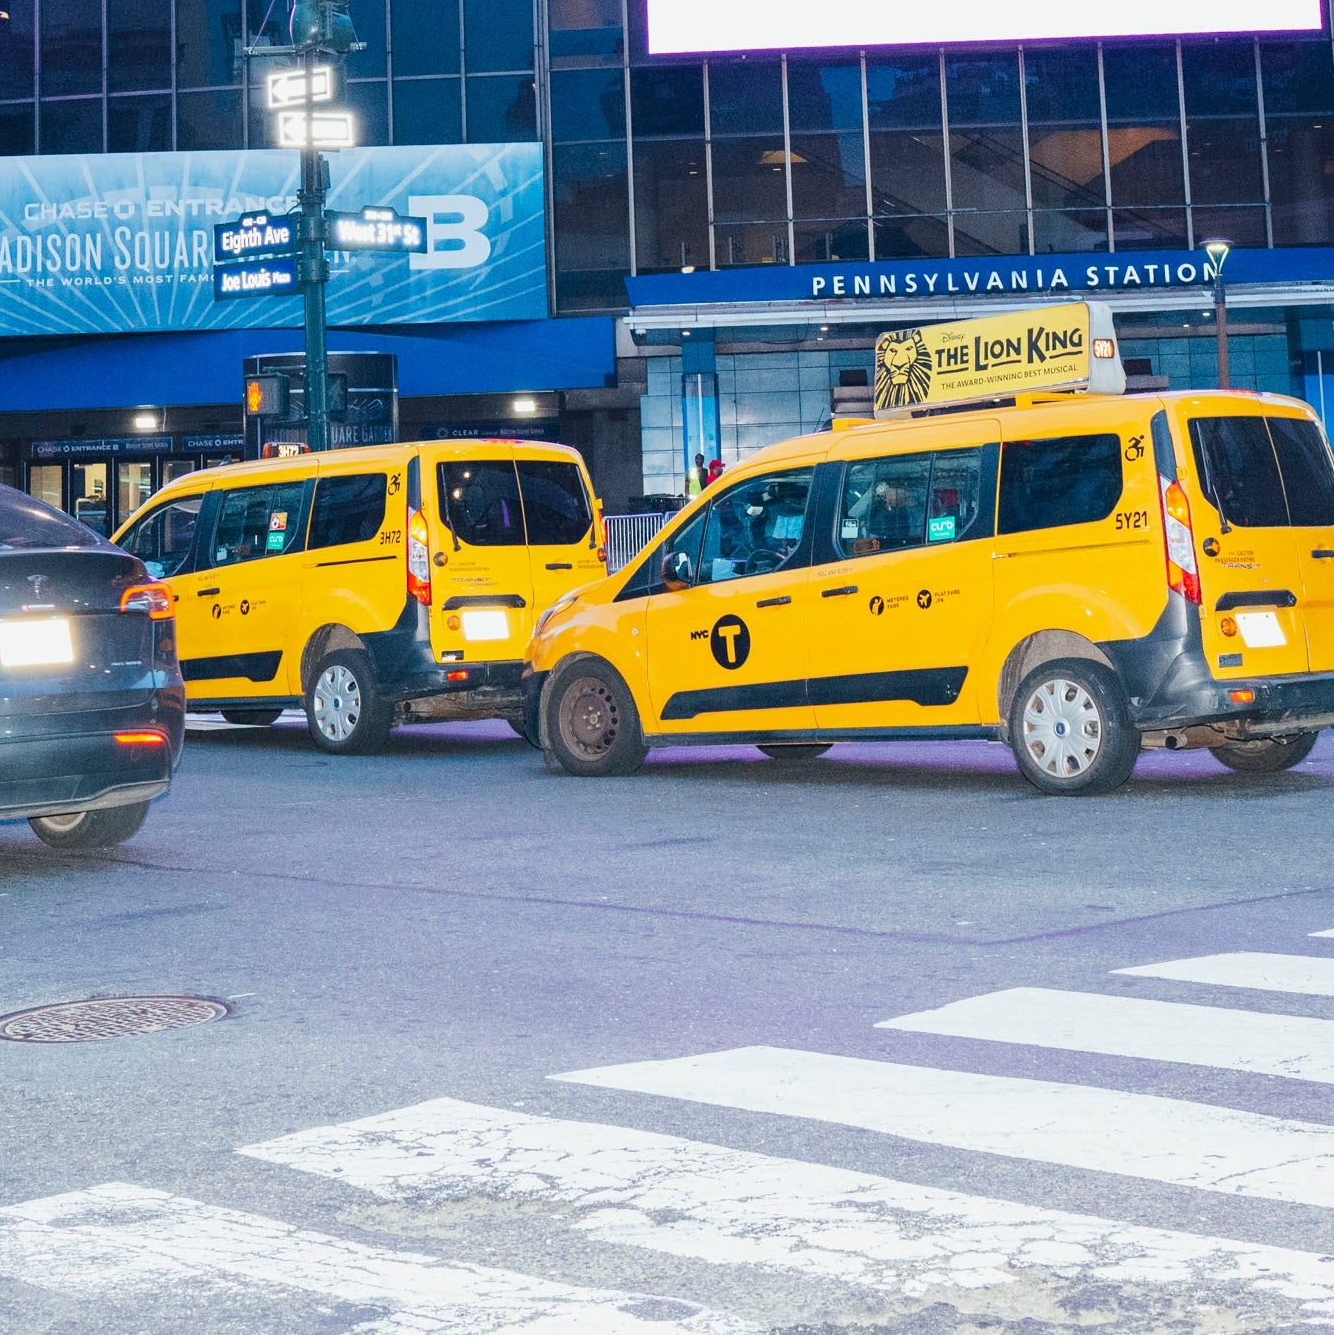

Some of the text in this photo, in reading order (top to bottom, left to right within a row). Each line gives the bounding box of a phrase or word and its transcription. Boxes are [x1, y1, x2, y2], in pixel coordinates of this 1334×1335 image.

[23, 195, 303, 221] CHASE ENTRANCE
[222, 225, 290, 254] Eighth Ave
[336, 219, 376, 244] West
[402, 223, 421, 246] St
[408, 194, 492, 271] B
[113, 225, 216, 274] SQUAR
[27, 277, 54, 287] THE
[61, 274, 127, 286] WORLD'S
[132, 273, 174, 285] MOST
[221, 272, 241, 292] Joe
[241, 267, 272, 290] Louis
[812, 262, 1218, 296] PENNSYLVANIA STATION
[935, 325, 1084, 372] THE LION KING
[941, 364, 1079, 391] THE AWARD-WINNING BEST MUSICAL
[36, 444, 62, 454] CHASE
[71, 444, 111, 452] ENTRANCE
[187, 438, 245, 447] CHASE ENTR
[278, 444, 301, 458] 3H72
[1115, 510, 1148, 530] 5Y21
[379, 528, 402, 546] 3H72
[690, 629, 709, 641] NYC
